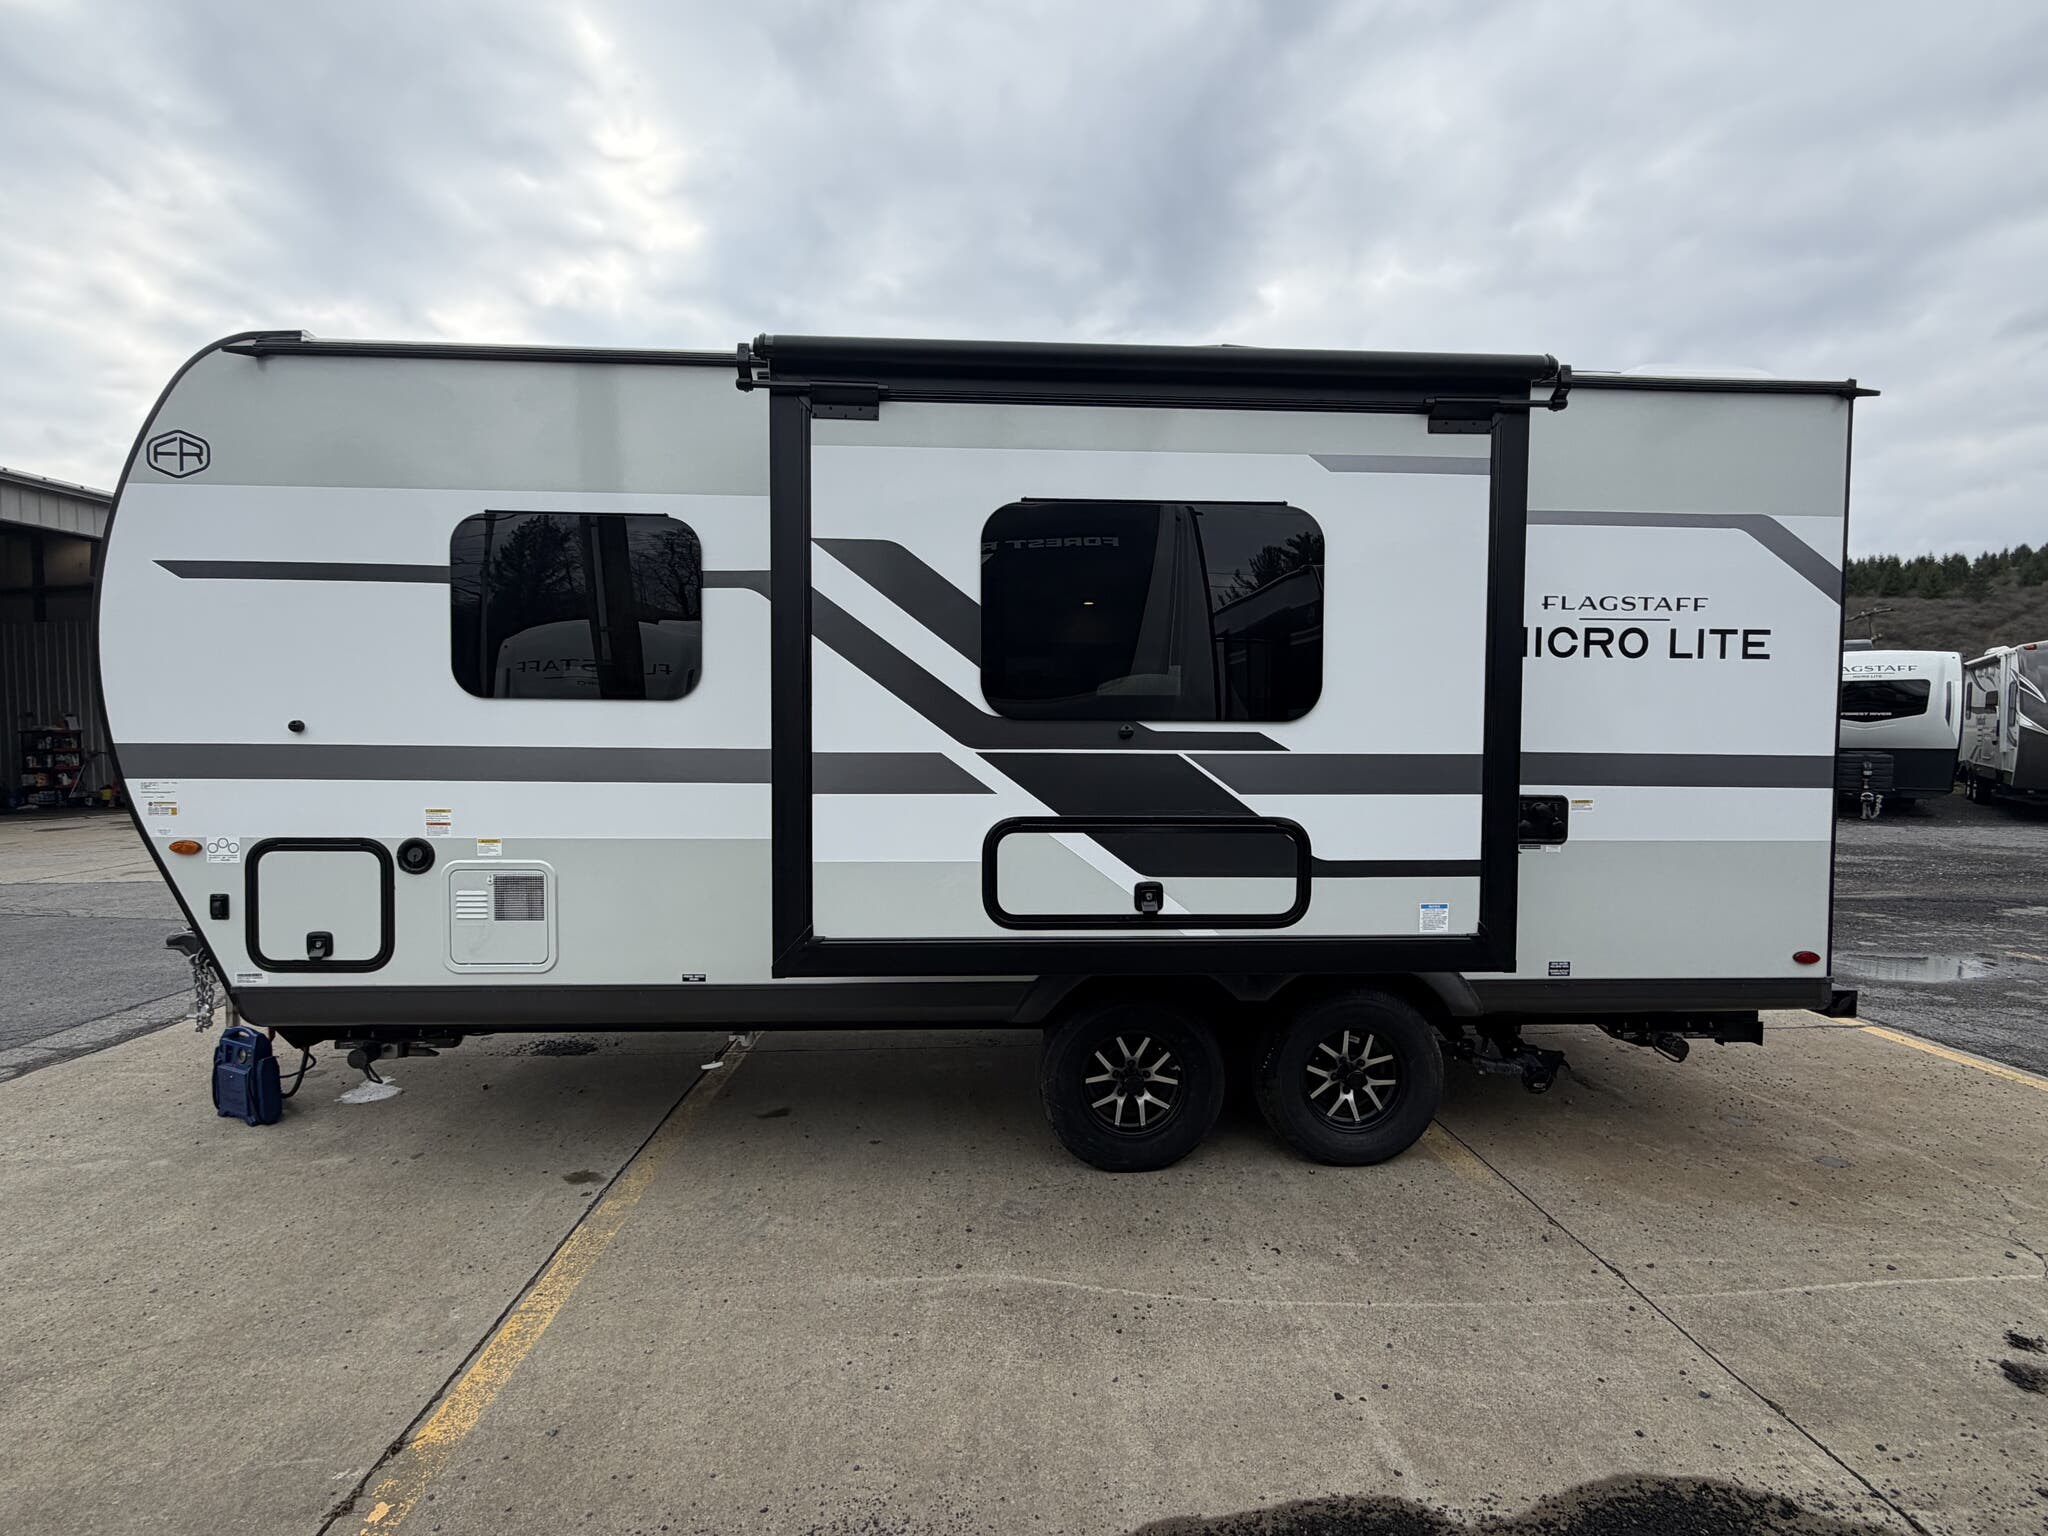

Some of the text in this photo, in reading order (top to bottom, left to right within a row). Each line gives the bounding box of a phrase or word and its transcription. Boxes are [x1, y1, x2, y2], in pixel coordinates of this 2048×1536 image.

[1541, 595, 1709, 612] FLAGSTAFF
[1522, 626, 1772, 660] ICRO LITE
[1842, 664, 1919, 673] AGSTAFF
